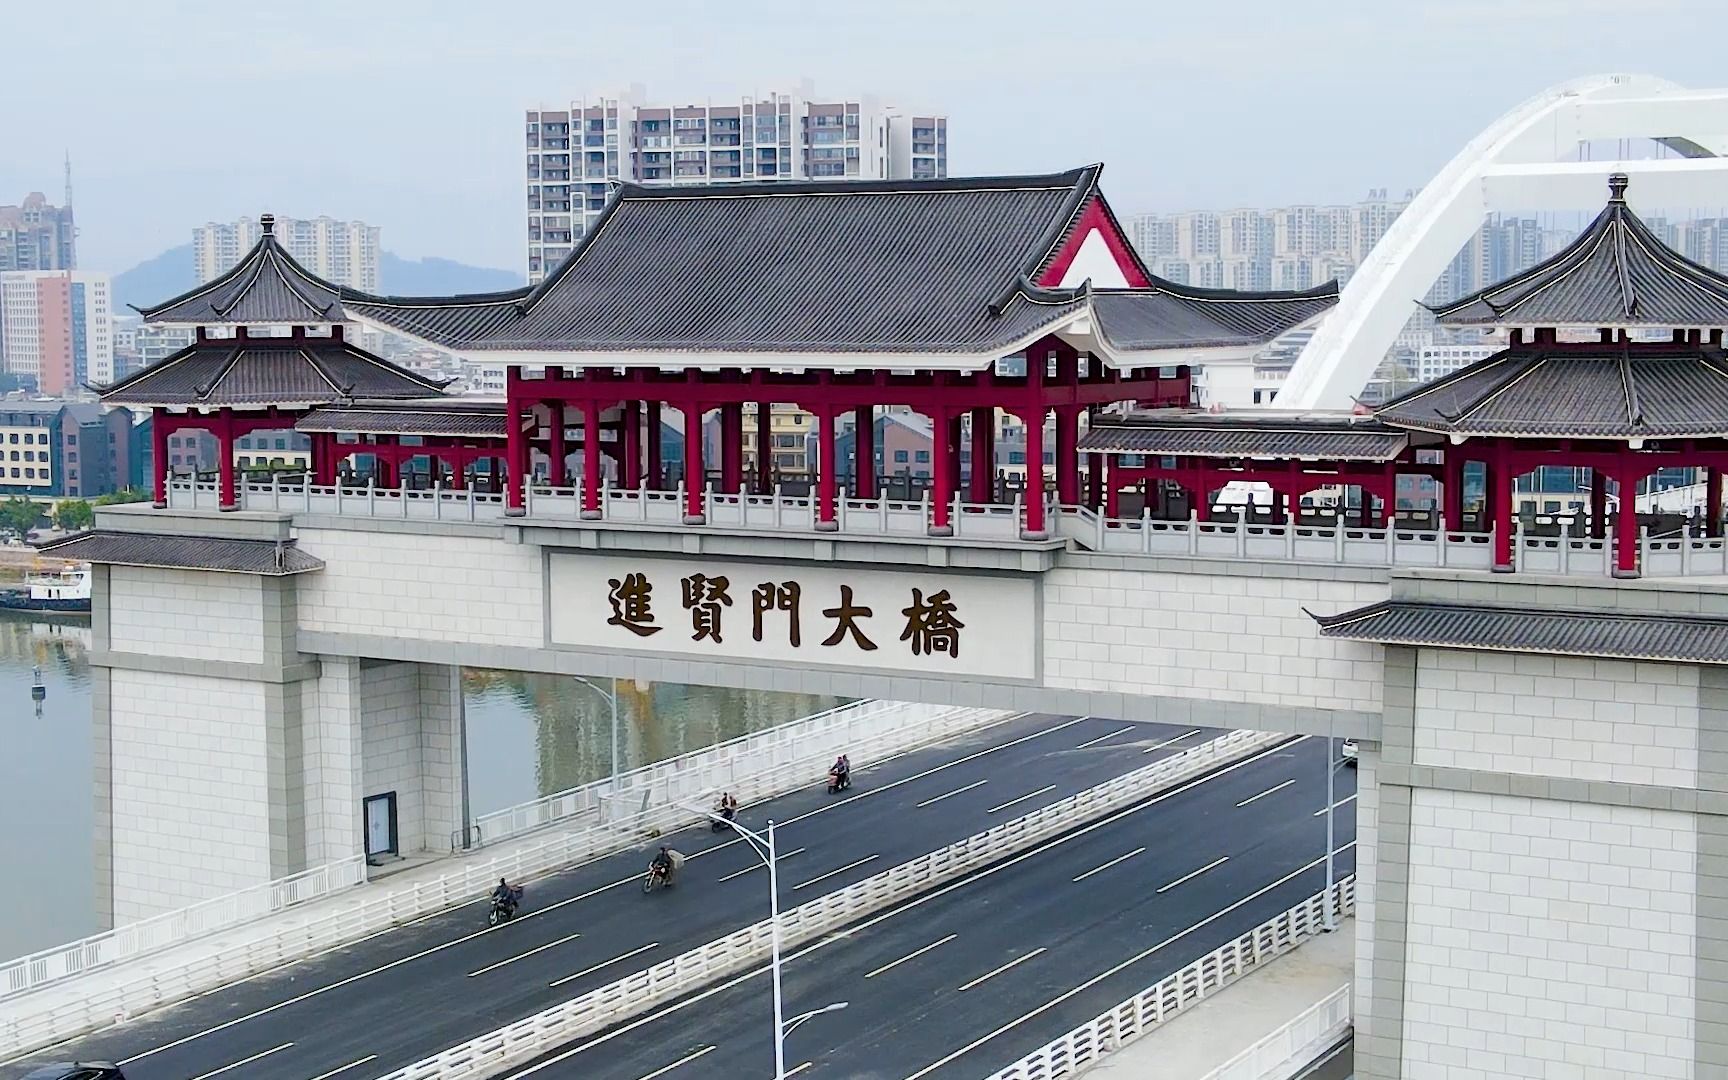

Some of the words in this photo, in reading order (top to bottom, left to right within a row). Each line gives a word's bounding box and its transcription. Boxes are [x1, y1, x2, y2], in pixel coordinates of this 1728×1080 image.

[607, 572, 966, 659] 進賢門大橋
